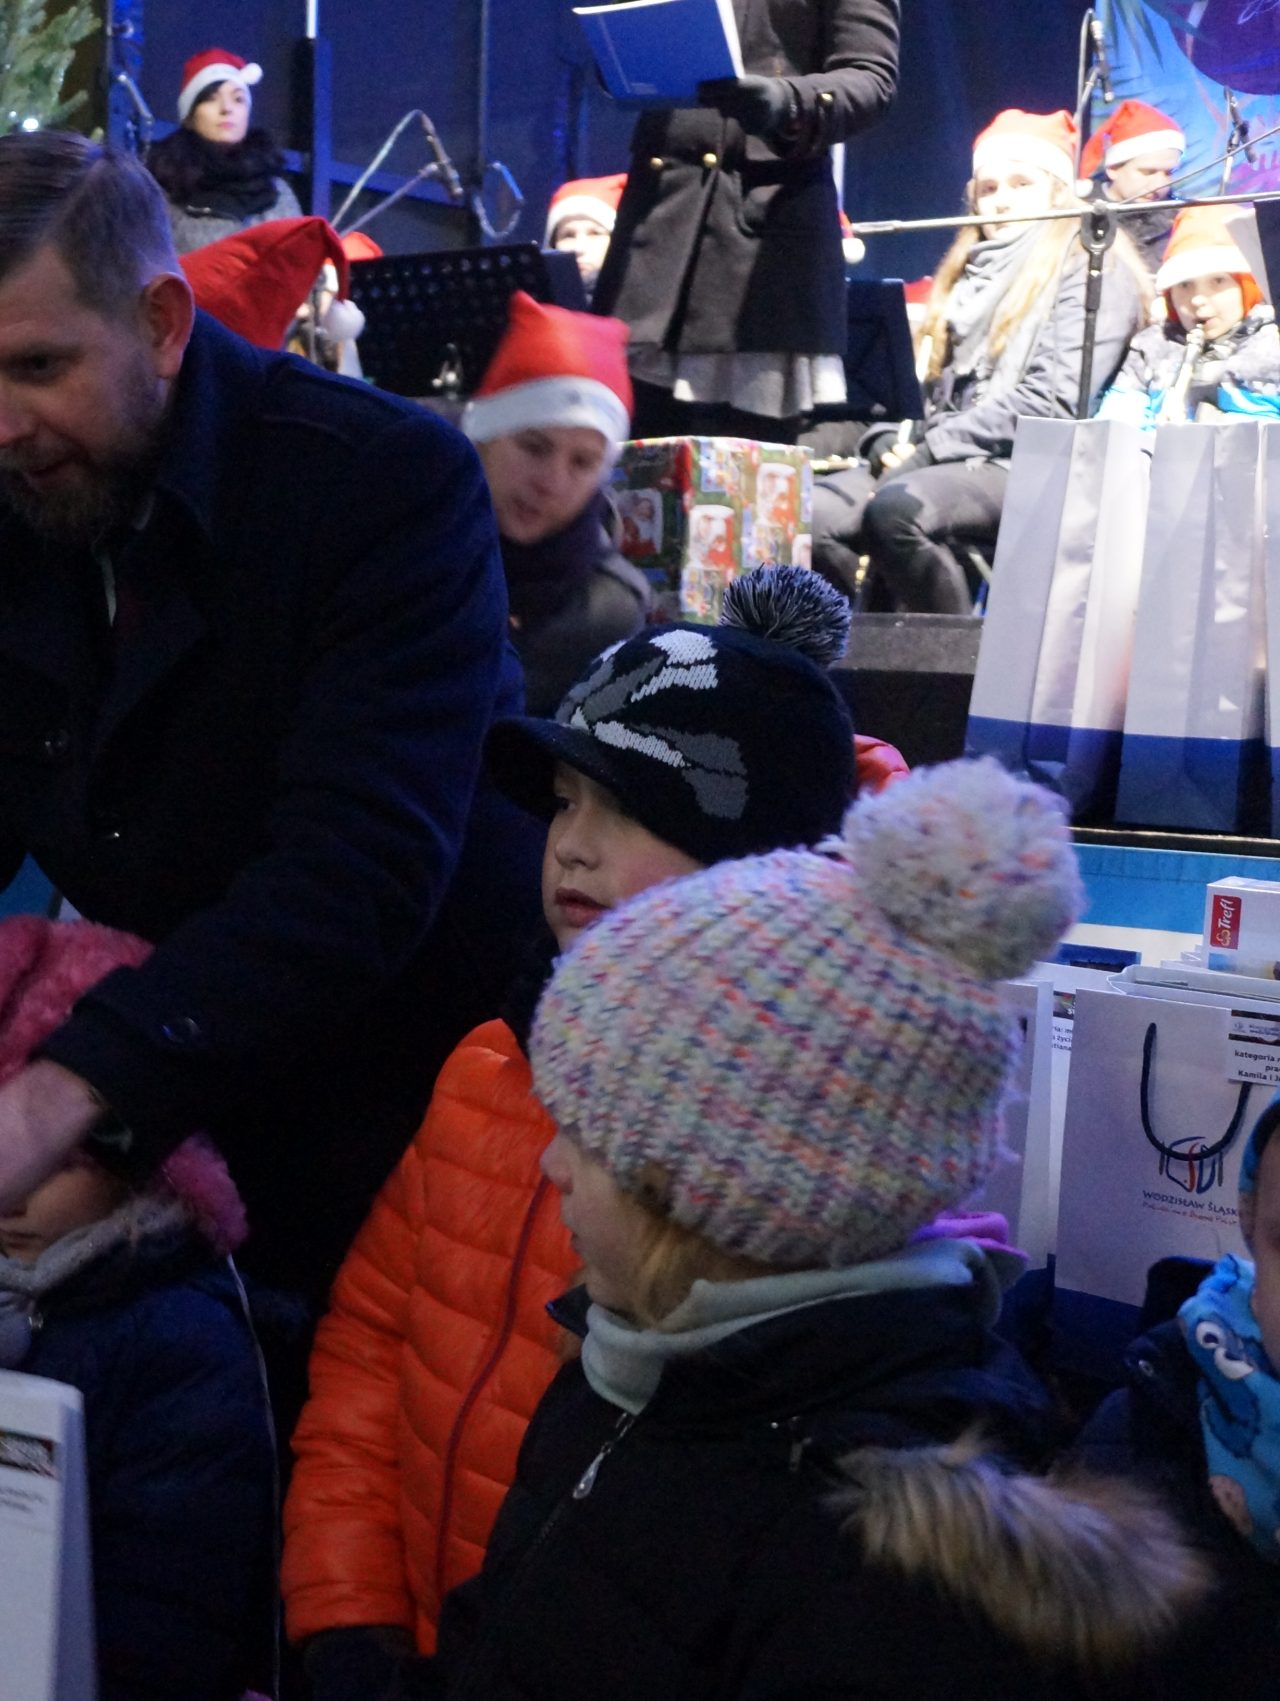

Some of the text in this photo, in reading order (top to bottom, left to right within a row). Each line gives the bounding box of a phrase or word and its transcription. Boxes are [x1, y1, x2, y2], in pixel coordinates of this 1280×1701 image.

[1218, 898, 1235, 929] Trefl
[1234, 1049, 1275, 1061] kategoria
[1238, 1069, 1268, 1080] Kamila
[1142, 1189, 1206, 1209] WODZISŁAW
[1207, 1200, 1239, 1217] ŚLĄSK
